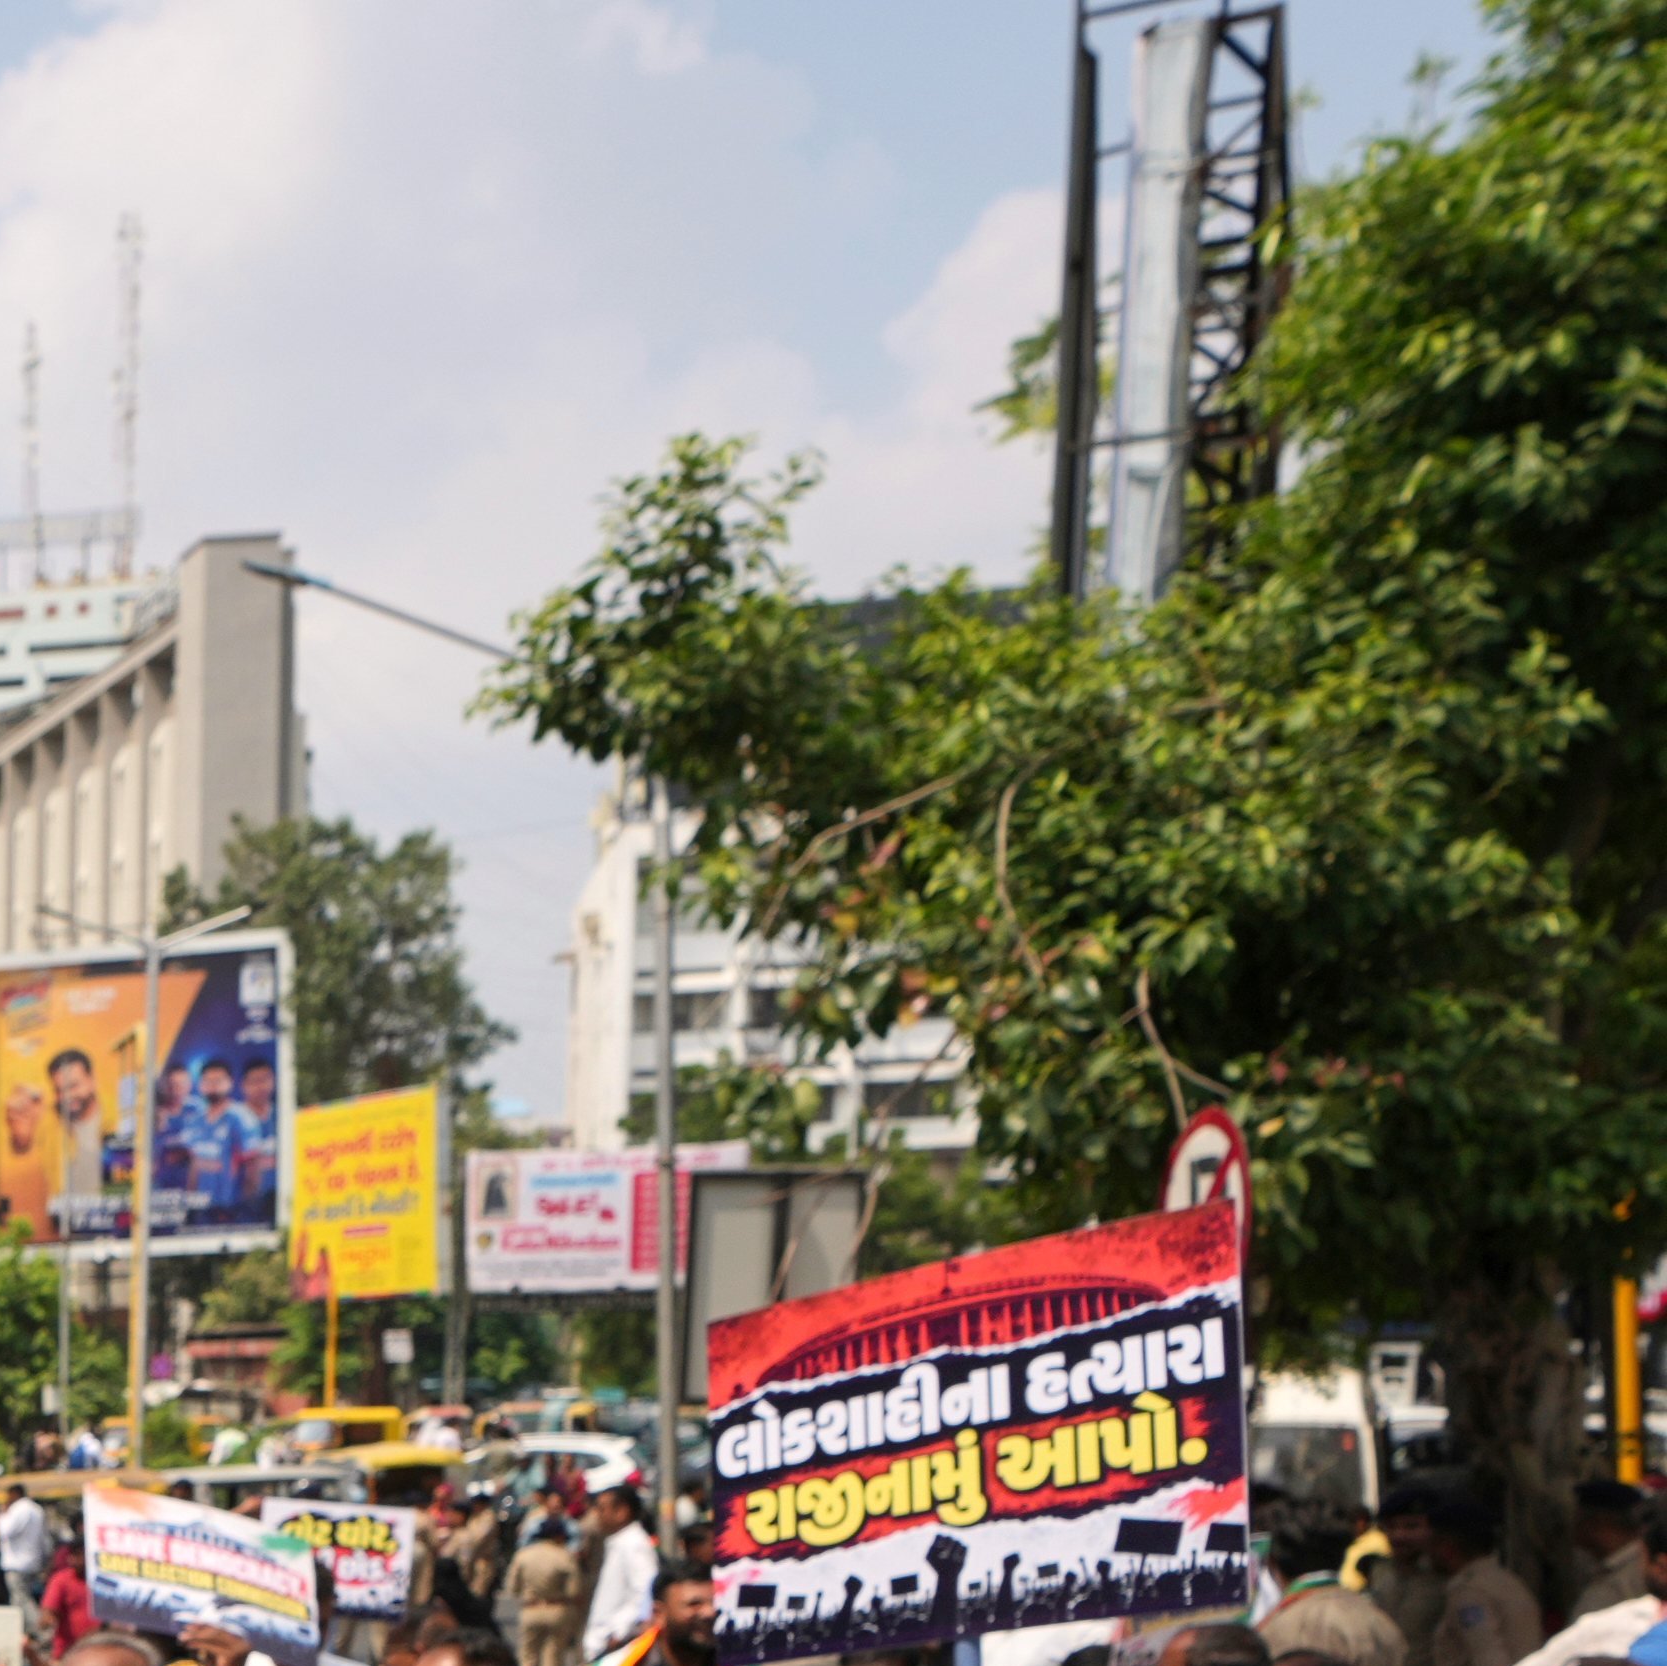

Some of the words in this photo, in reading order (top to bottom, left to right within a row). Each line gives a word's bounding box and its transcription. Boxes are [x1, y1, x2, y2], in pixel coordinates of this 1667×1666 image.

[715, 1361, 1011, 1479] લોકશાહીના
[1025, 1316, 1226, 1415] હત્યારા
[745, 1428, 988, 1547] રાજીનામું
[996, 1390, 1208, 1491] આપો.
